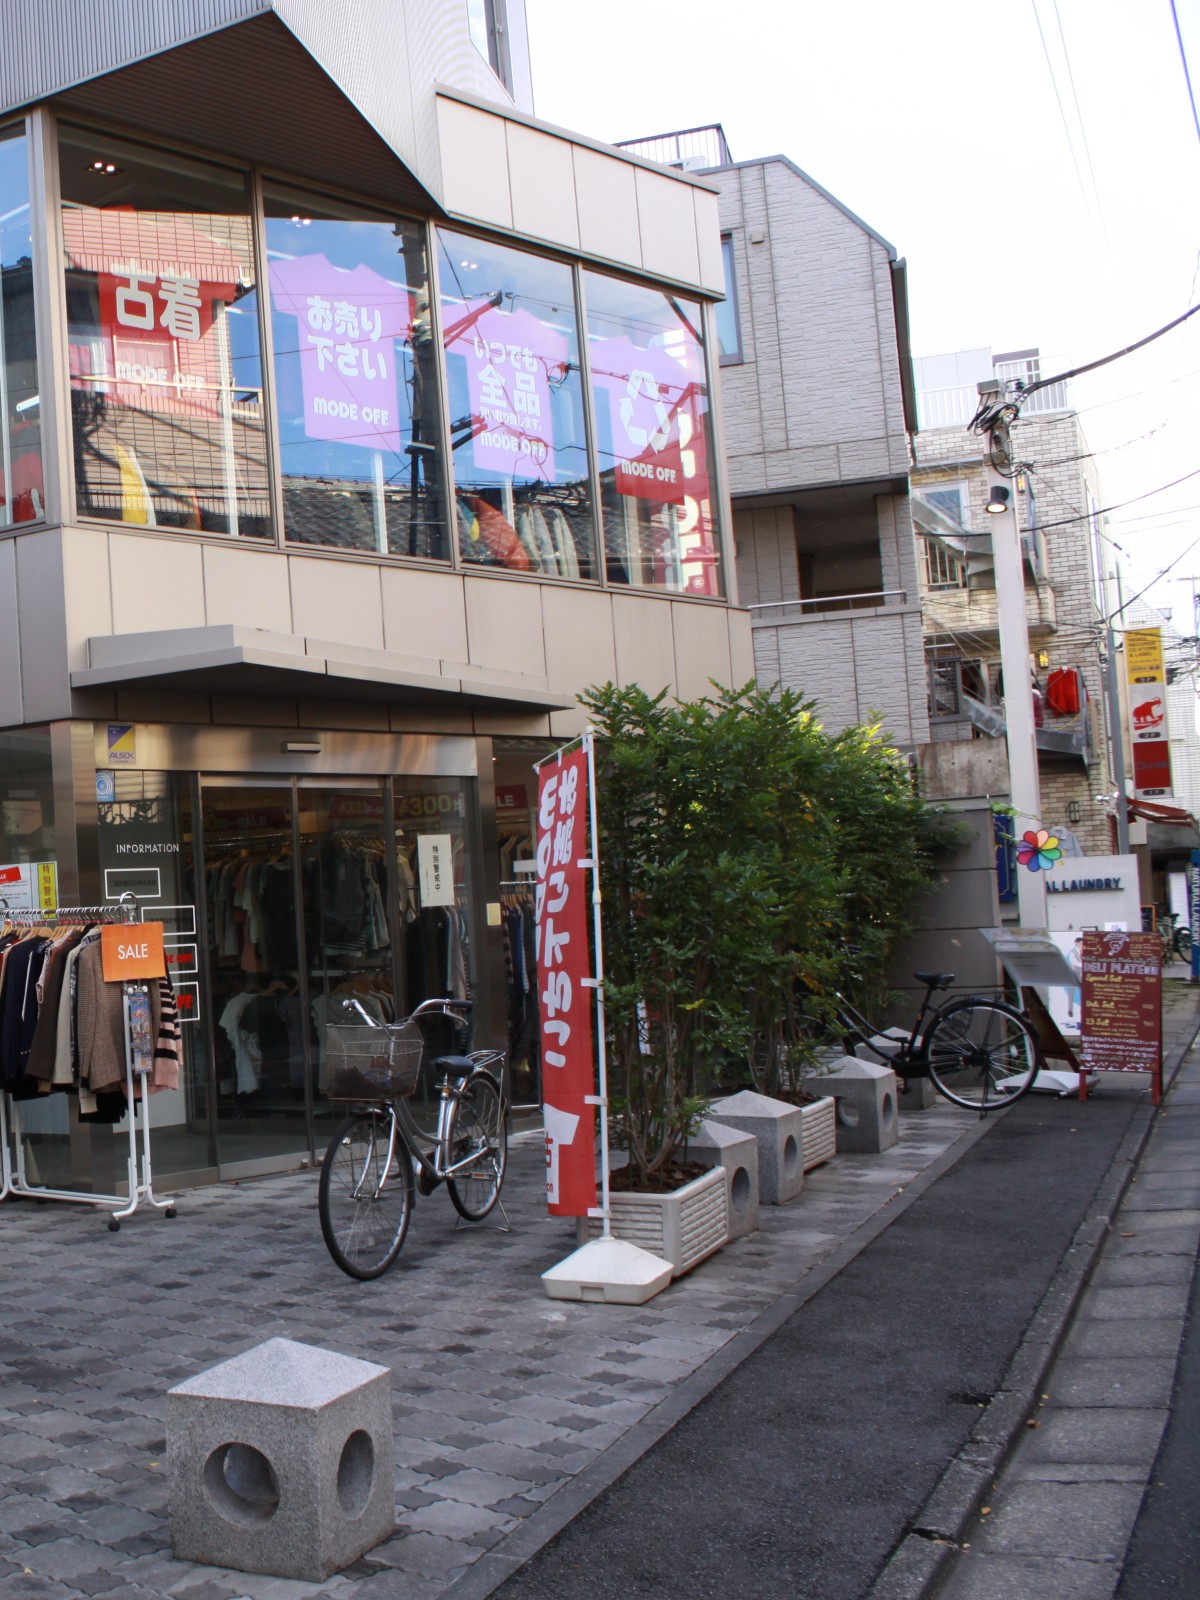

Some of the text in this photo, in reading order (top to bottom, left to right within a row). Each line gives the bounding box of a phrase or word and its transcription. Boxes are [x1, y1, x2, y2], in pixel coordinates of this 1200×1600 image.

[110, 258, 202, 341] 古着
[307, 295, 382, 342] お売り
[307, 335, 387, 380] 下さい
[474, 336, 538, 373] いつでも
[116, 361, 168, 384] MODE
[477, 364, 541, 416] 全品
[313, 397, 389, 426] MODE OFF
[480, 431, 519, 451] MODE
[621, 459, 676, 484] MODE OFF
[496, 795, 514, 807] LE
[116, 844, 179, 853] INFORMATION
[1062, 877, 1121, 891] LAUNDRY
[1192, 908, 1200, 945] LAUNDRY
[118, 944, 148, 960] SALE
[1083, 962, 1106, 972] DELI
